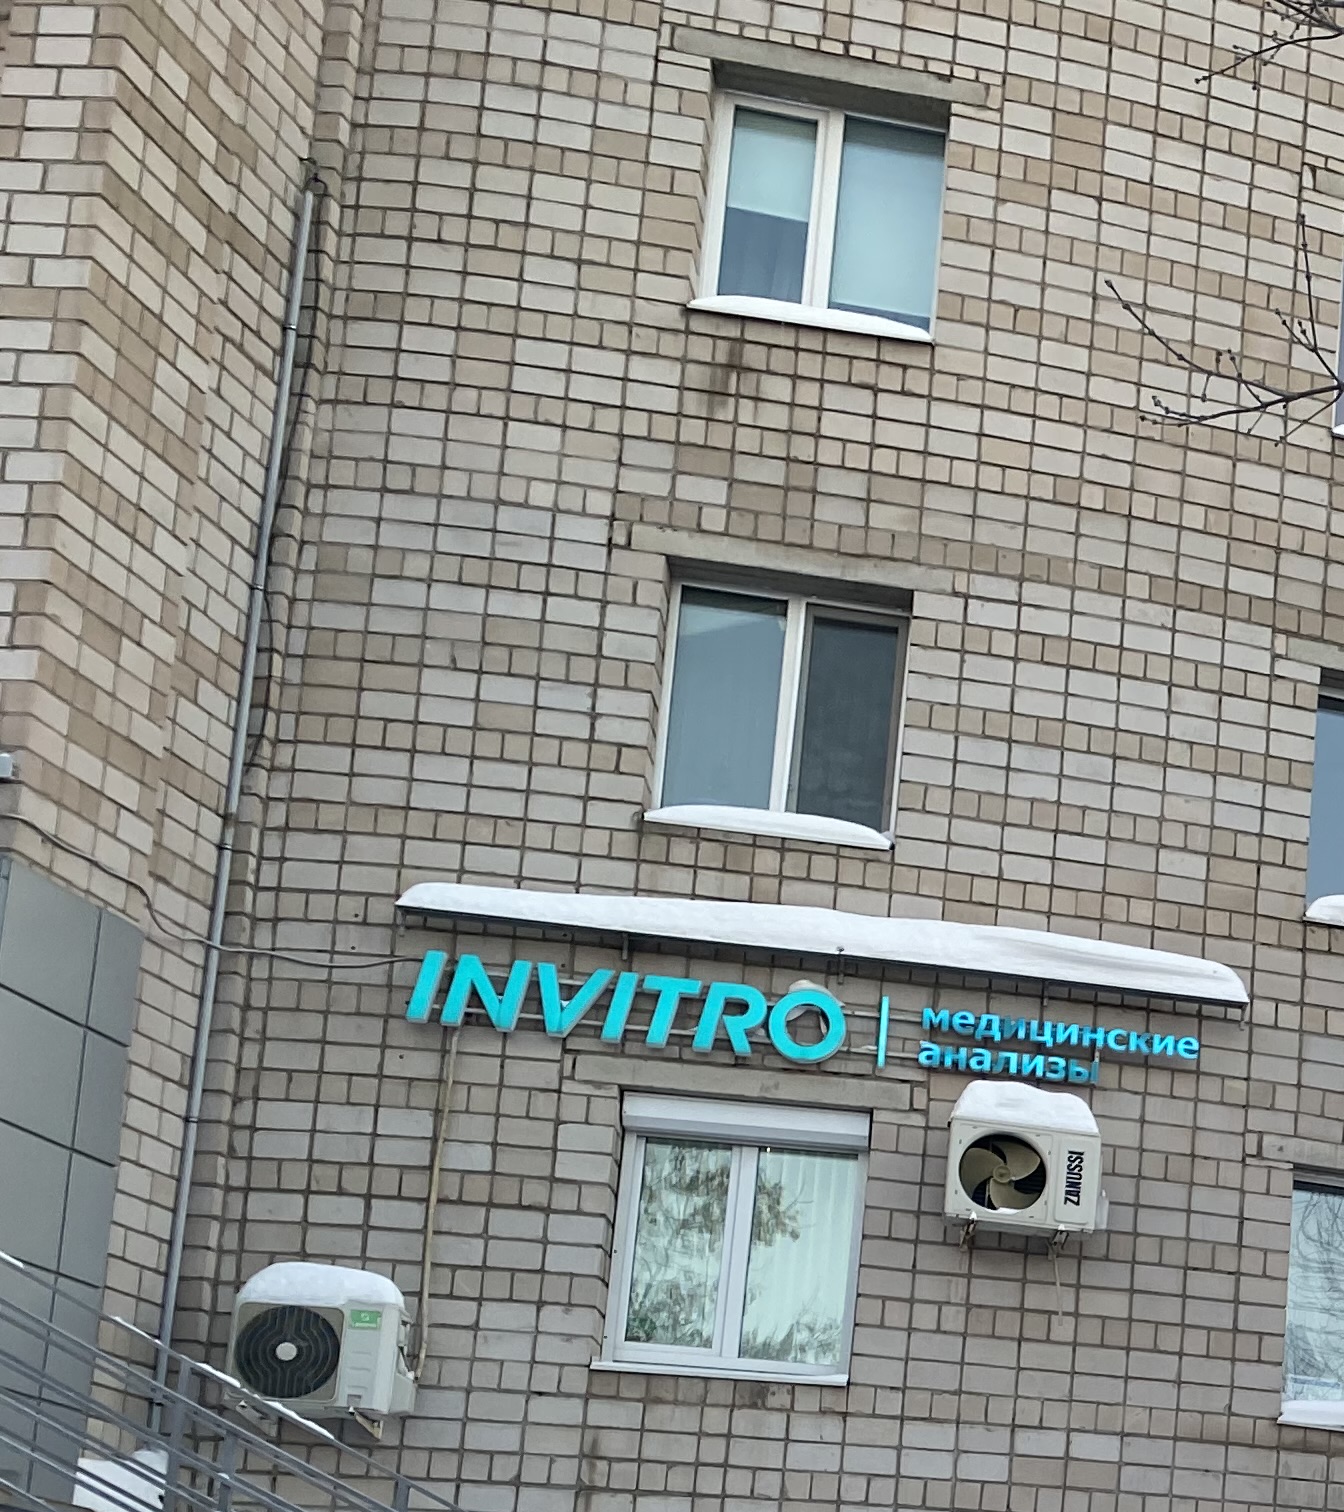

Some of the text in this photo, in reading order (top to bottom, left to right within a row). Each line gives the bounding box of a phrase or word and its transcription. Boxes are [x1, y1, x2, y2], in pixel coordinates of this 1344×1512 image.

[406, 950, 847, 1064] INVITRO
[921, 1006, 1200, 1060] медицинские
[917, 1040, 1100, 1084] анализы
[1064, 1150, 1085, 1206] ZANUSSI
